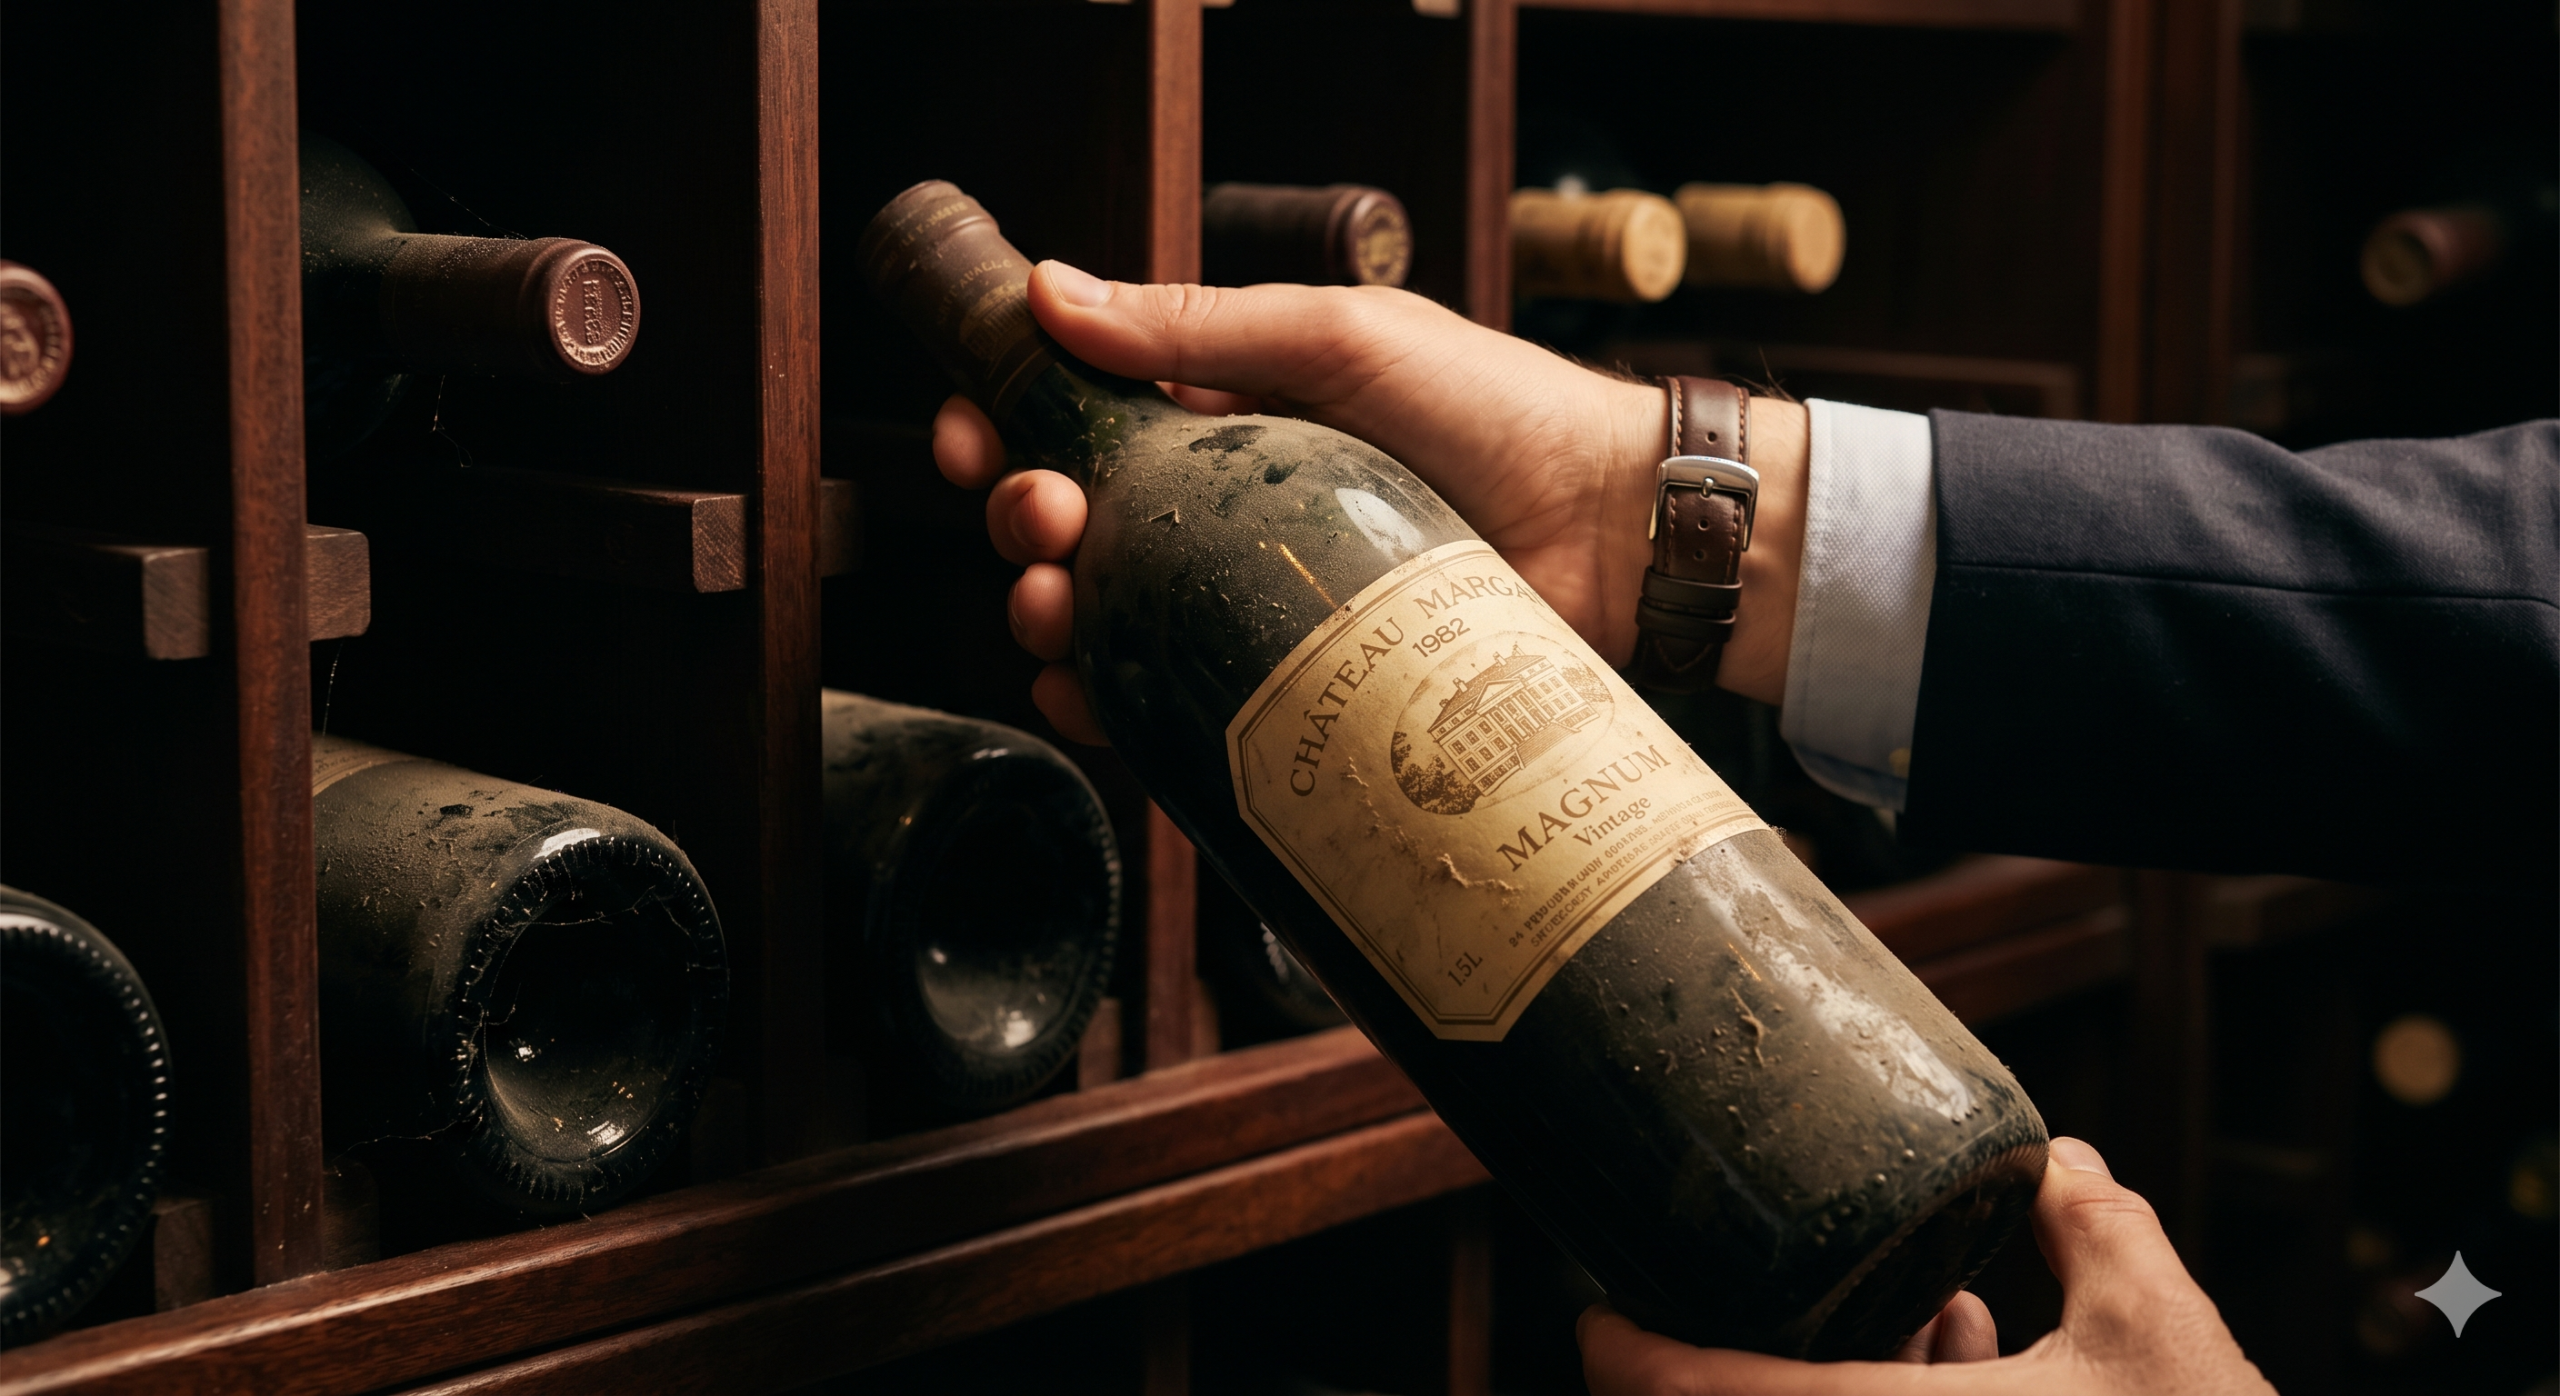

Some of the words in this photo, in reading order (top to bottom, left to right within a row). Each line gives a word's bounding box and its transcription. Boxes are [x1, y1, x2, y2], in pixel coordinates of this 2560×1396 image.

[1412, 617, 1471, 658] 1982
[1290, 616, 1404, 797] CHÂTEAU
[1496, 744, 1672, 872] MAGNUM
[1572, 797, 1651, 847] Vintage
[1447, 951, 1484, 987] 1.5L
